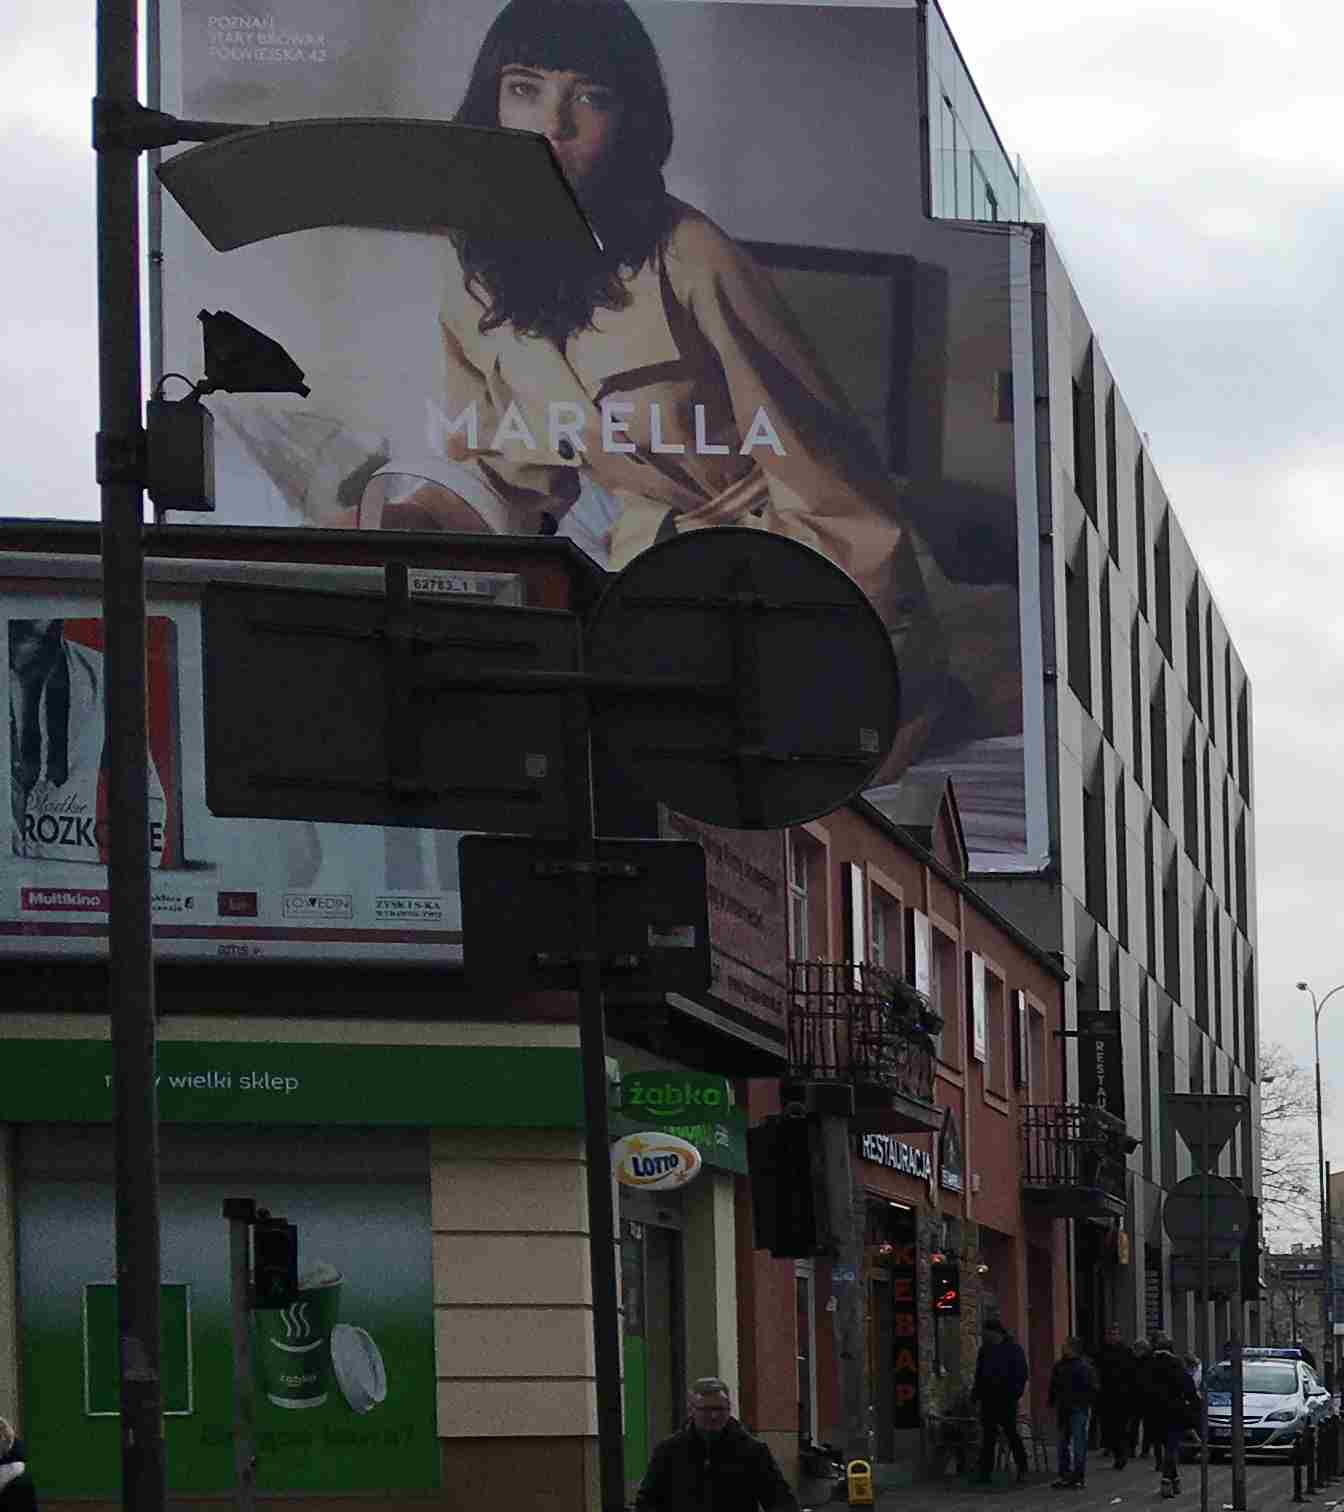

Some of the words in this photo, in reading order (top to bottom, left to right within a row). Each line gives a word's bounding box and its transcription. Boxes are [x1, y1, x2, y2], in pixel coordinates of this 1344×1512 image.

[423, 397, 787, 457] MARELLA
[28, 892, 103, 908] Multikino
[168, 1071, 232, 1089] wielki
[239, 1072, 300, 1095] sklep
[628, 1080, 721, 1106] żabka
[862, 1133, 931, 1180] RESTAURACJA
